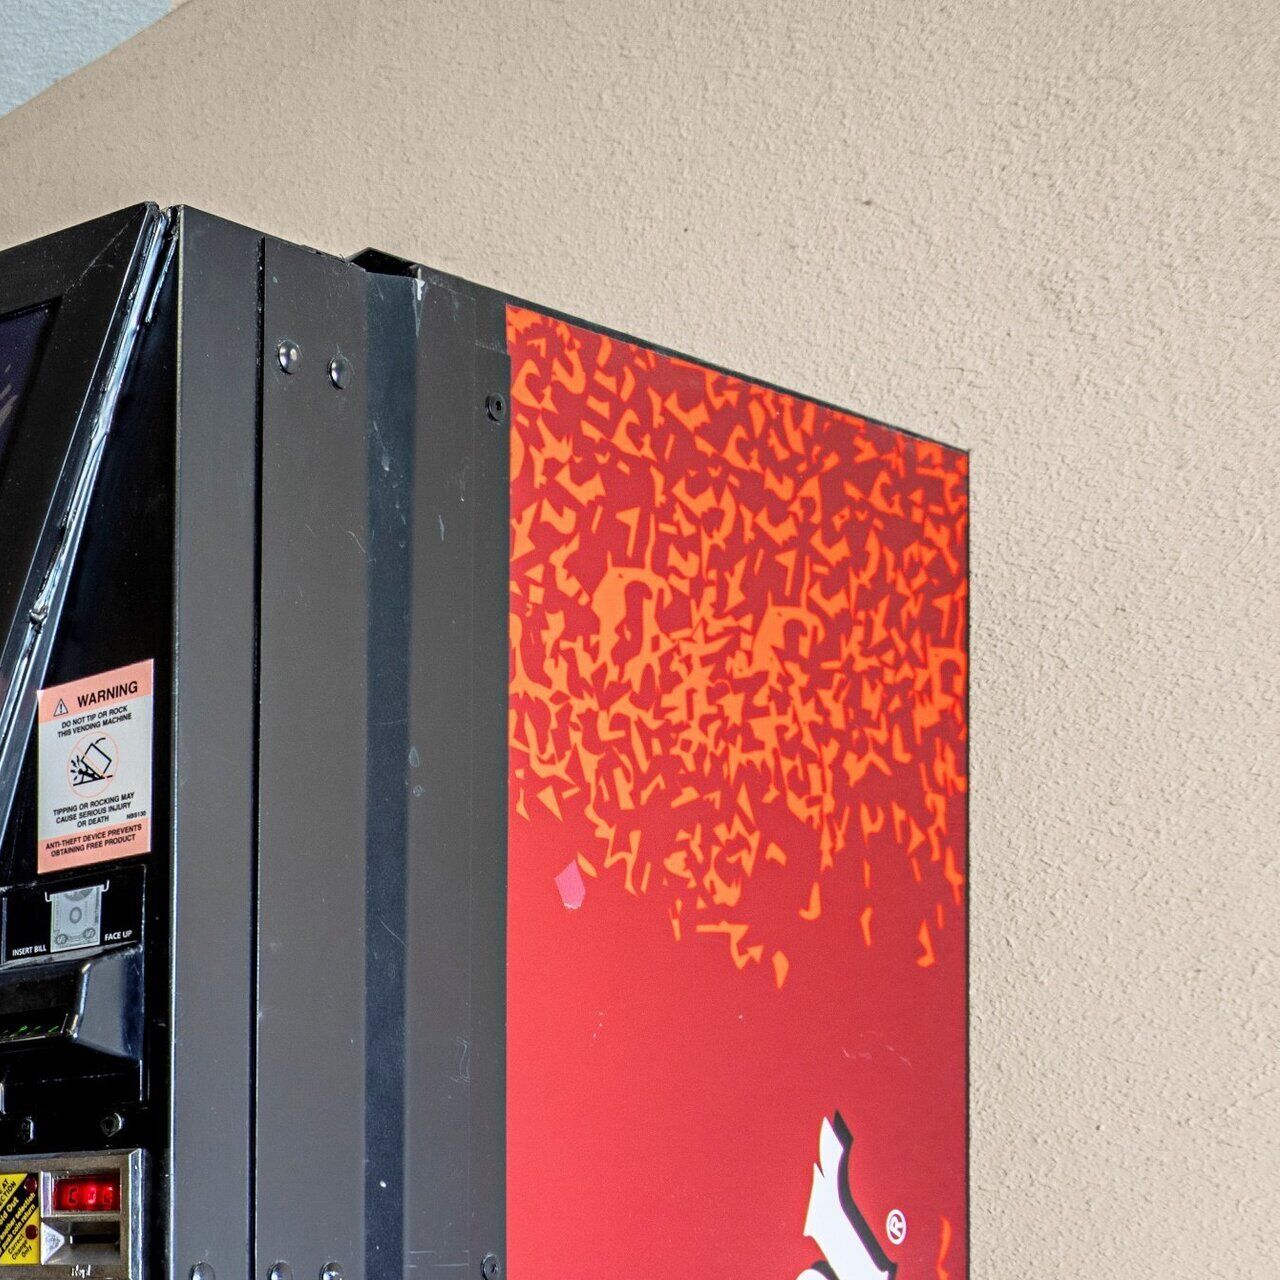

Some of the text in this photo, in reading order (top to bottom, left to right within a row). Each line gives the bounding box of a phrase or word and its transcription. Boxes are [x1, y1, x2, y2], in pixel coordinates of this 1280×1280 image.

[77, 681, 137, 707] WARNING
[57, 713, 132, 738] THIS VENDING MACHINE
[61, 705, 127, 728] DO NOT TIP OR ROCK
[53, 792, 135, 816] TIPPING OR ROCKING MAY
[56, 801, 132, 824] CAUSE SERIOUS INJURY
[77, 815, 109, 828] OR DEATH
[45, 823, 142, 850] ANTI-THEFT DEVICE PREVENTS
[51, 834, 136, 857] OBTAINING FREE PRODUCT
[104, 929, 133, 941] FACE UP
[12, 944, 47, 956] INSERT BILL
[2, 1178, 9, 1189] AT
[6, 1196, 19, 1212] Out
[11, 1221, 22, 1235] coin
[7, 1233, 24, 1254] Correct
